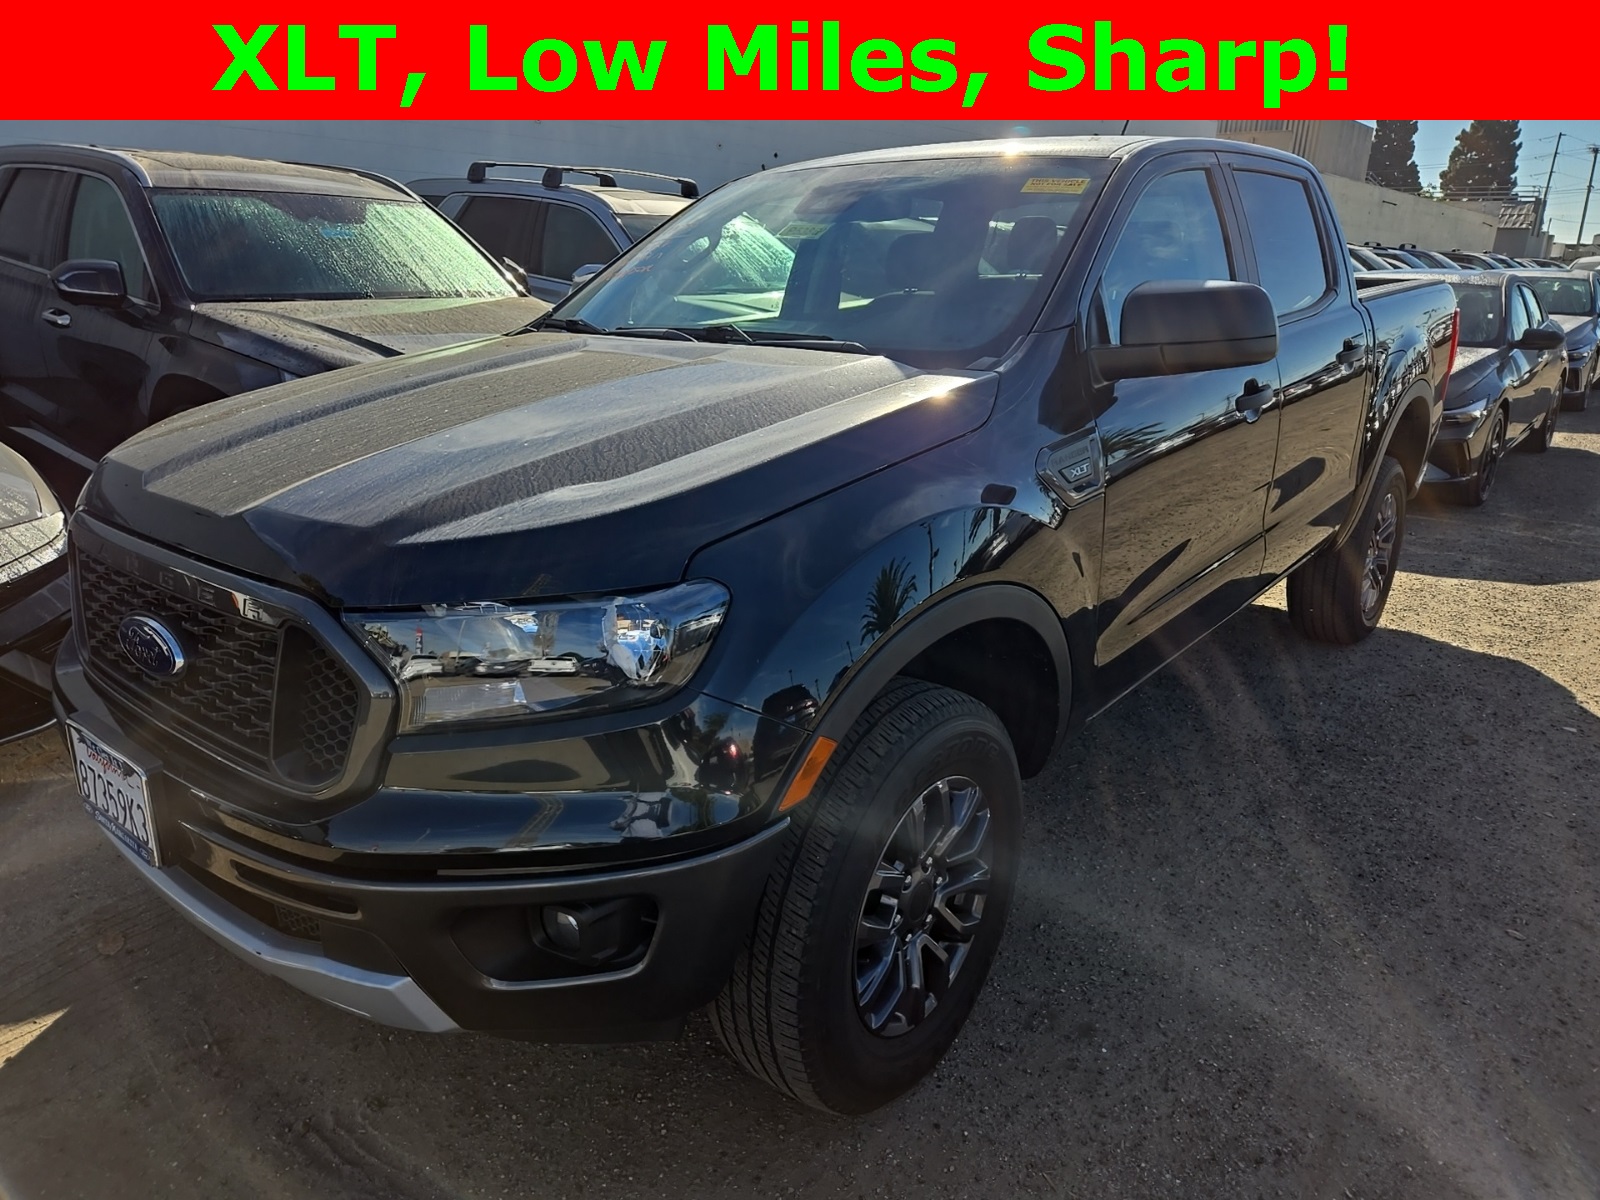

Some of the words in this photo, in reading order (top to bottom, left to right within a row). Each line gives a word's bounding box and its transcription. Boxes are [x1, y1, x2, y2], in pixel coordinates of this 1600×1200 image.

[1070, 463, 1090, 478] XLT
[125, 625, 161, 667] Ford
[79, 759, 150, 848] 87359K3
